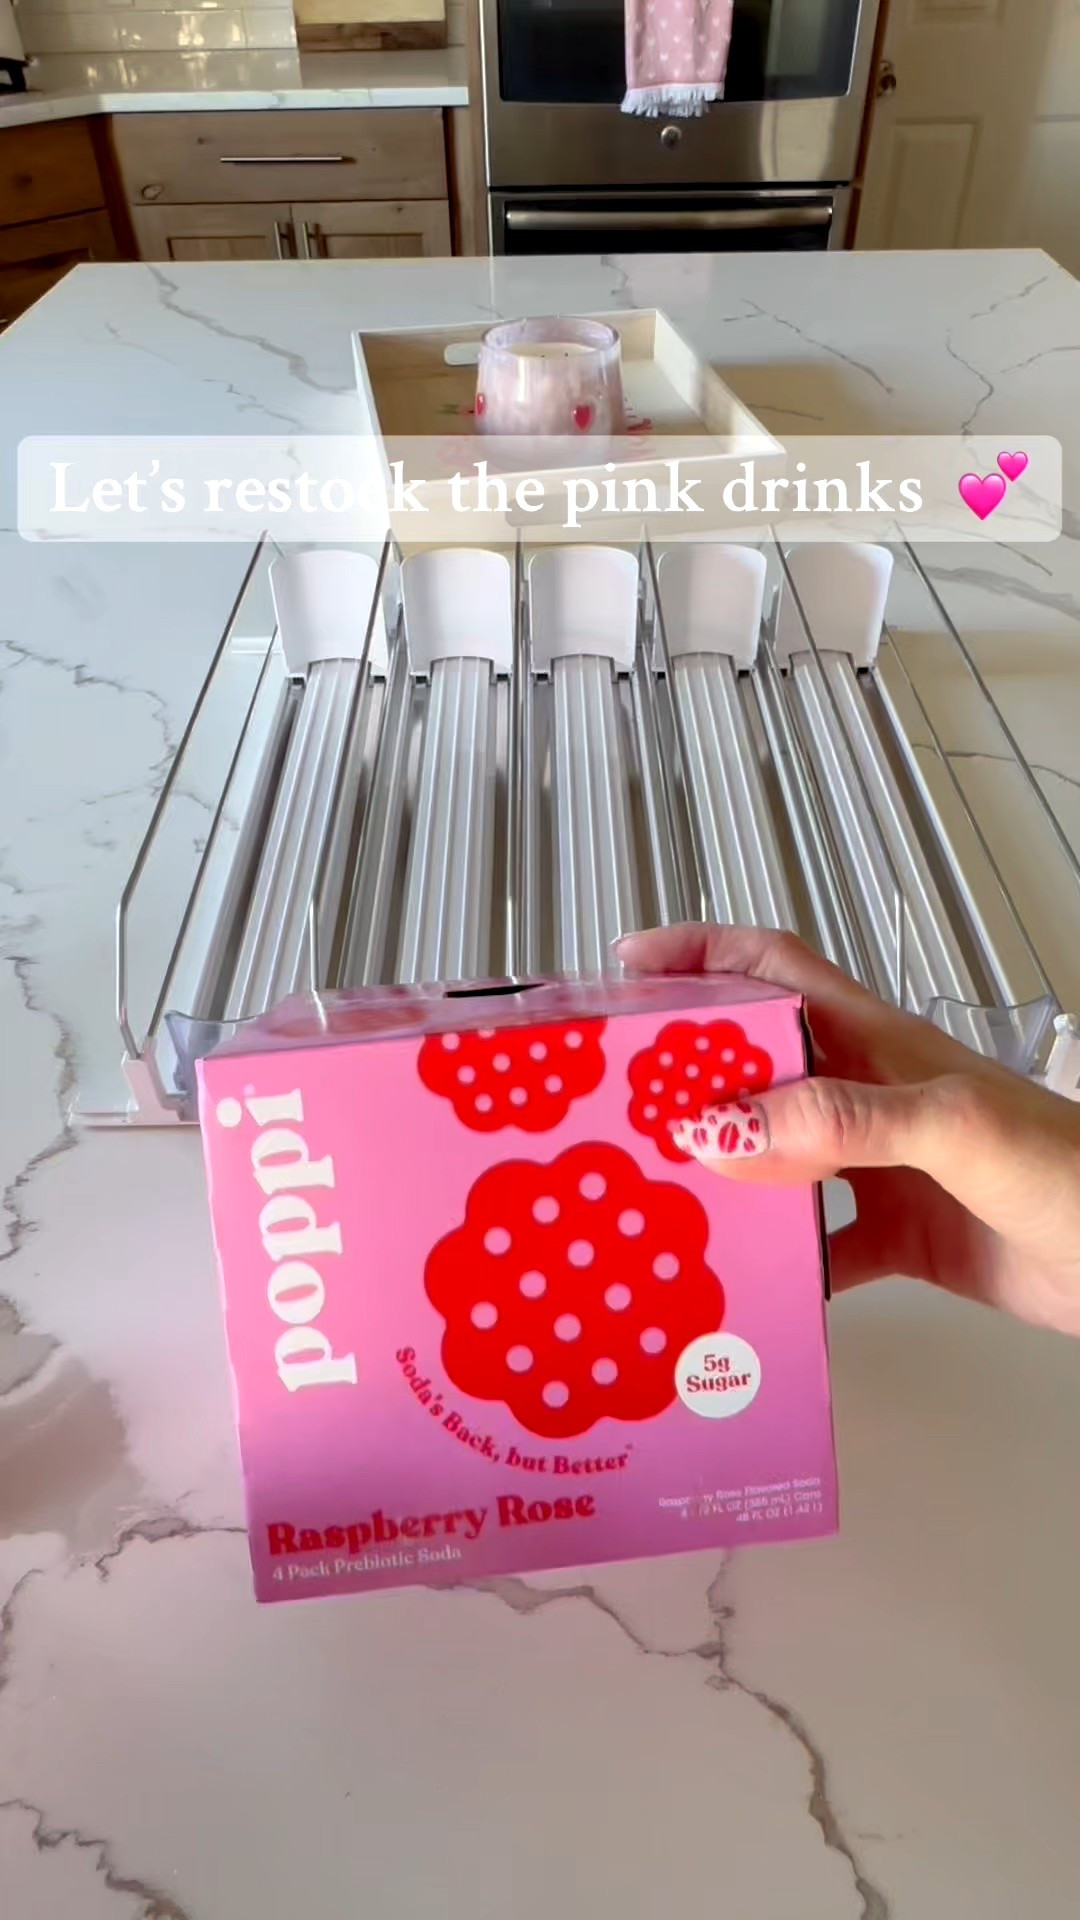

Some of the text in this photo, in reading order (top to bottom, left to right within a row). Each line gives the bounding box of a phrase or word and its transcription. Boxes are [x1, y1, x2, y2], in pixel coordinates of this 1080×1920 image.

[215, 1087, 358, 1393] poppi
[685, 1353, 752, 1393] 5g Sugar
[395, 1346, 444, 1417] Soda's
[441, 1411, 501, 1463] Back,
[505, 1446, 547, 1473] but
[266, 1493, 597, 1556] Raspberry Rose
[272, 1545, 462, 1580] 4 Pack Prebiotic Soda
